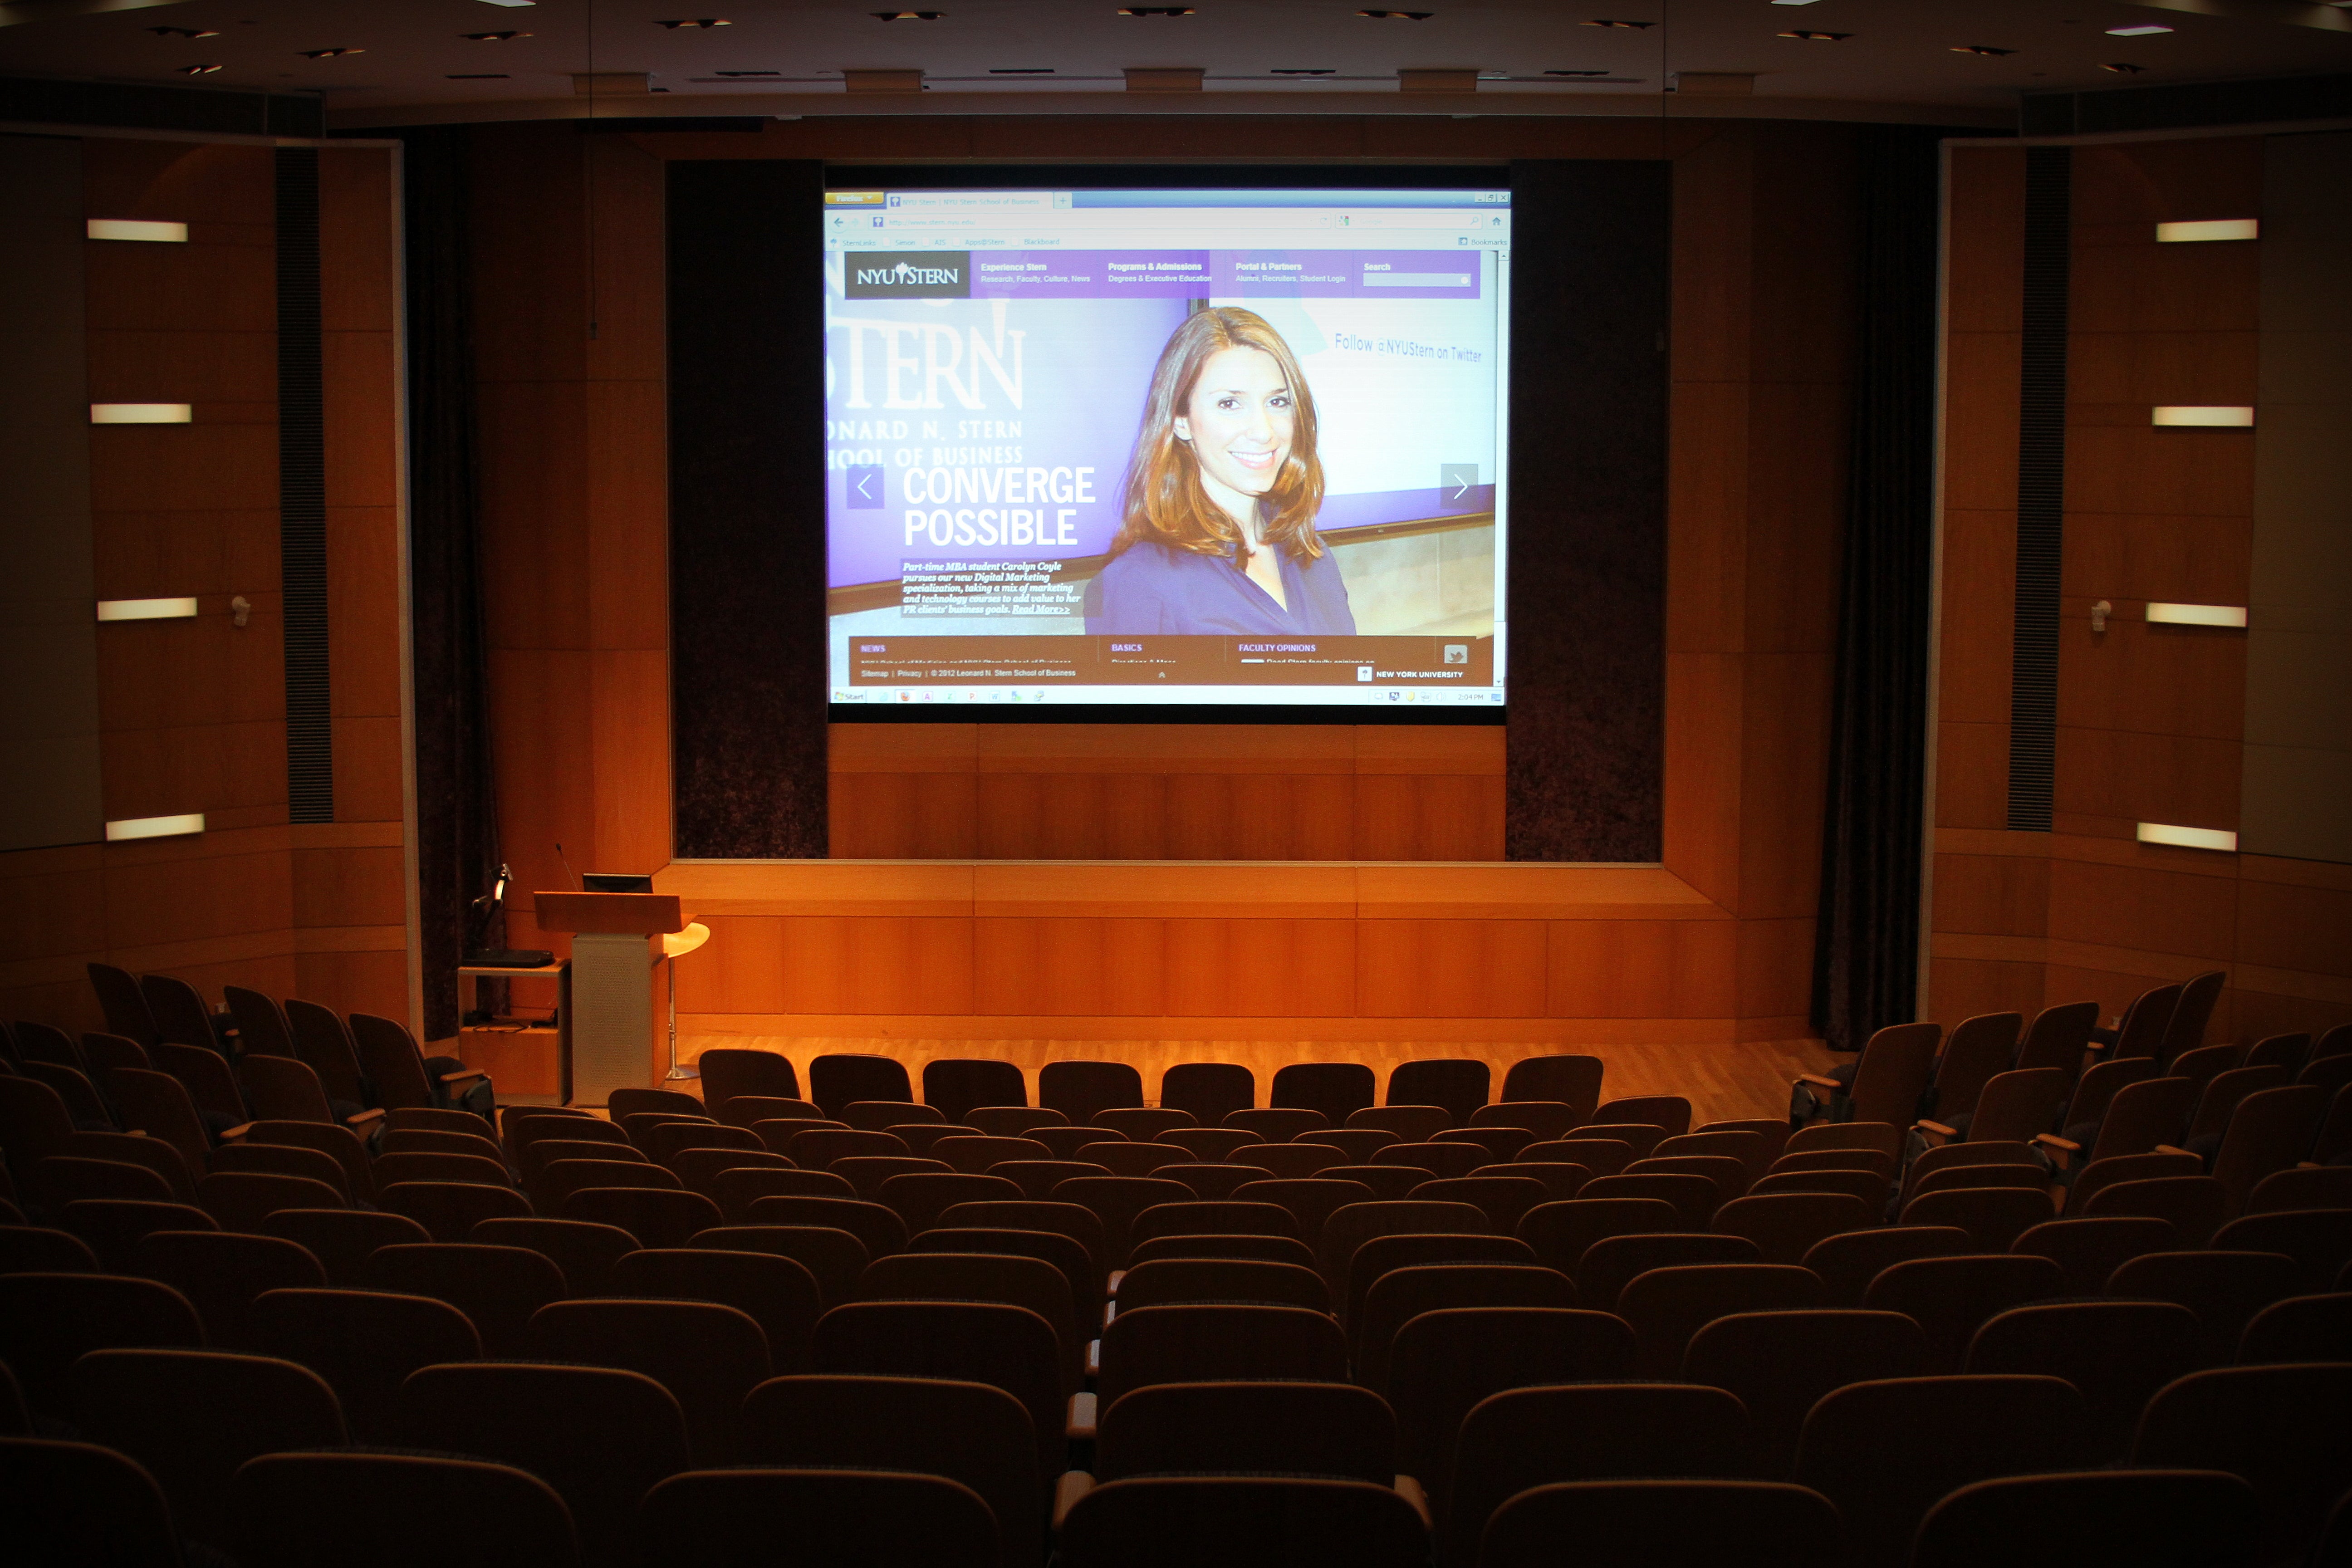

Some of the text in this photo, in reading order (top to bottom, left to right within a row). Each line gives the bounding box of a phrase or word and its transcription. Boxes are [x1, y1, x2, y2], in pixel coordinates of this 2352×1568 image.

[980, 263, 1024, 272] Experience
[1108, 263, 1147, 272] Programs
[1156, 263, 1202, 271] Admissions
[1364, 263, 1391, 271] Search
[858, 267, 958, 284] NYU STERN
[1108, 275, 1137, 283] Degrees
[1328, 275, 1346, 283] Login
[1335, 333, 1481, 363] Follow @NYUStern on Twitter
[923, 420, 946, 441] N.
[958, 420, 1023, 439] STERN
[894, 448, 923, 467] OF
[932, 446, 1023, 466] BUSINESS
[903, 466, 1097, 505] CONVERGE
[905, 509, 1078, 547] POSSIBLE
[902, 562, 1062, 573] Part-time MBA student Carolyn Coyle
[902, 575, 936, 583] pursues
[974, 573, 1004, 584] Digital
[1005, 573, 1050, 583] Marketing
[902, 584, 964, 594] specialization,
[965, 584, 992, 594] taking
[1019, 584, 1028, 594] of
[1029, 584, 1073, 594] marketing
[902, 594, 920, 603] and
[921, 594, 967, 605] technology
[1012, 594, 1029, 603] add
[1030, 594, 1054, 603] value
[1065, 594, 1081, 603] her
[903, 605, 916, 613] PR
[917, 605, 947, 614] clients'
[948, 605, 984, 614] business
[985, 605, 1010, 615] goals.
[1012, 605, 1036, 614] Read
